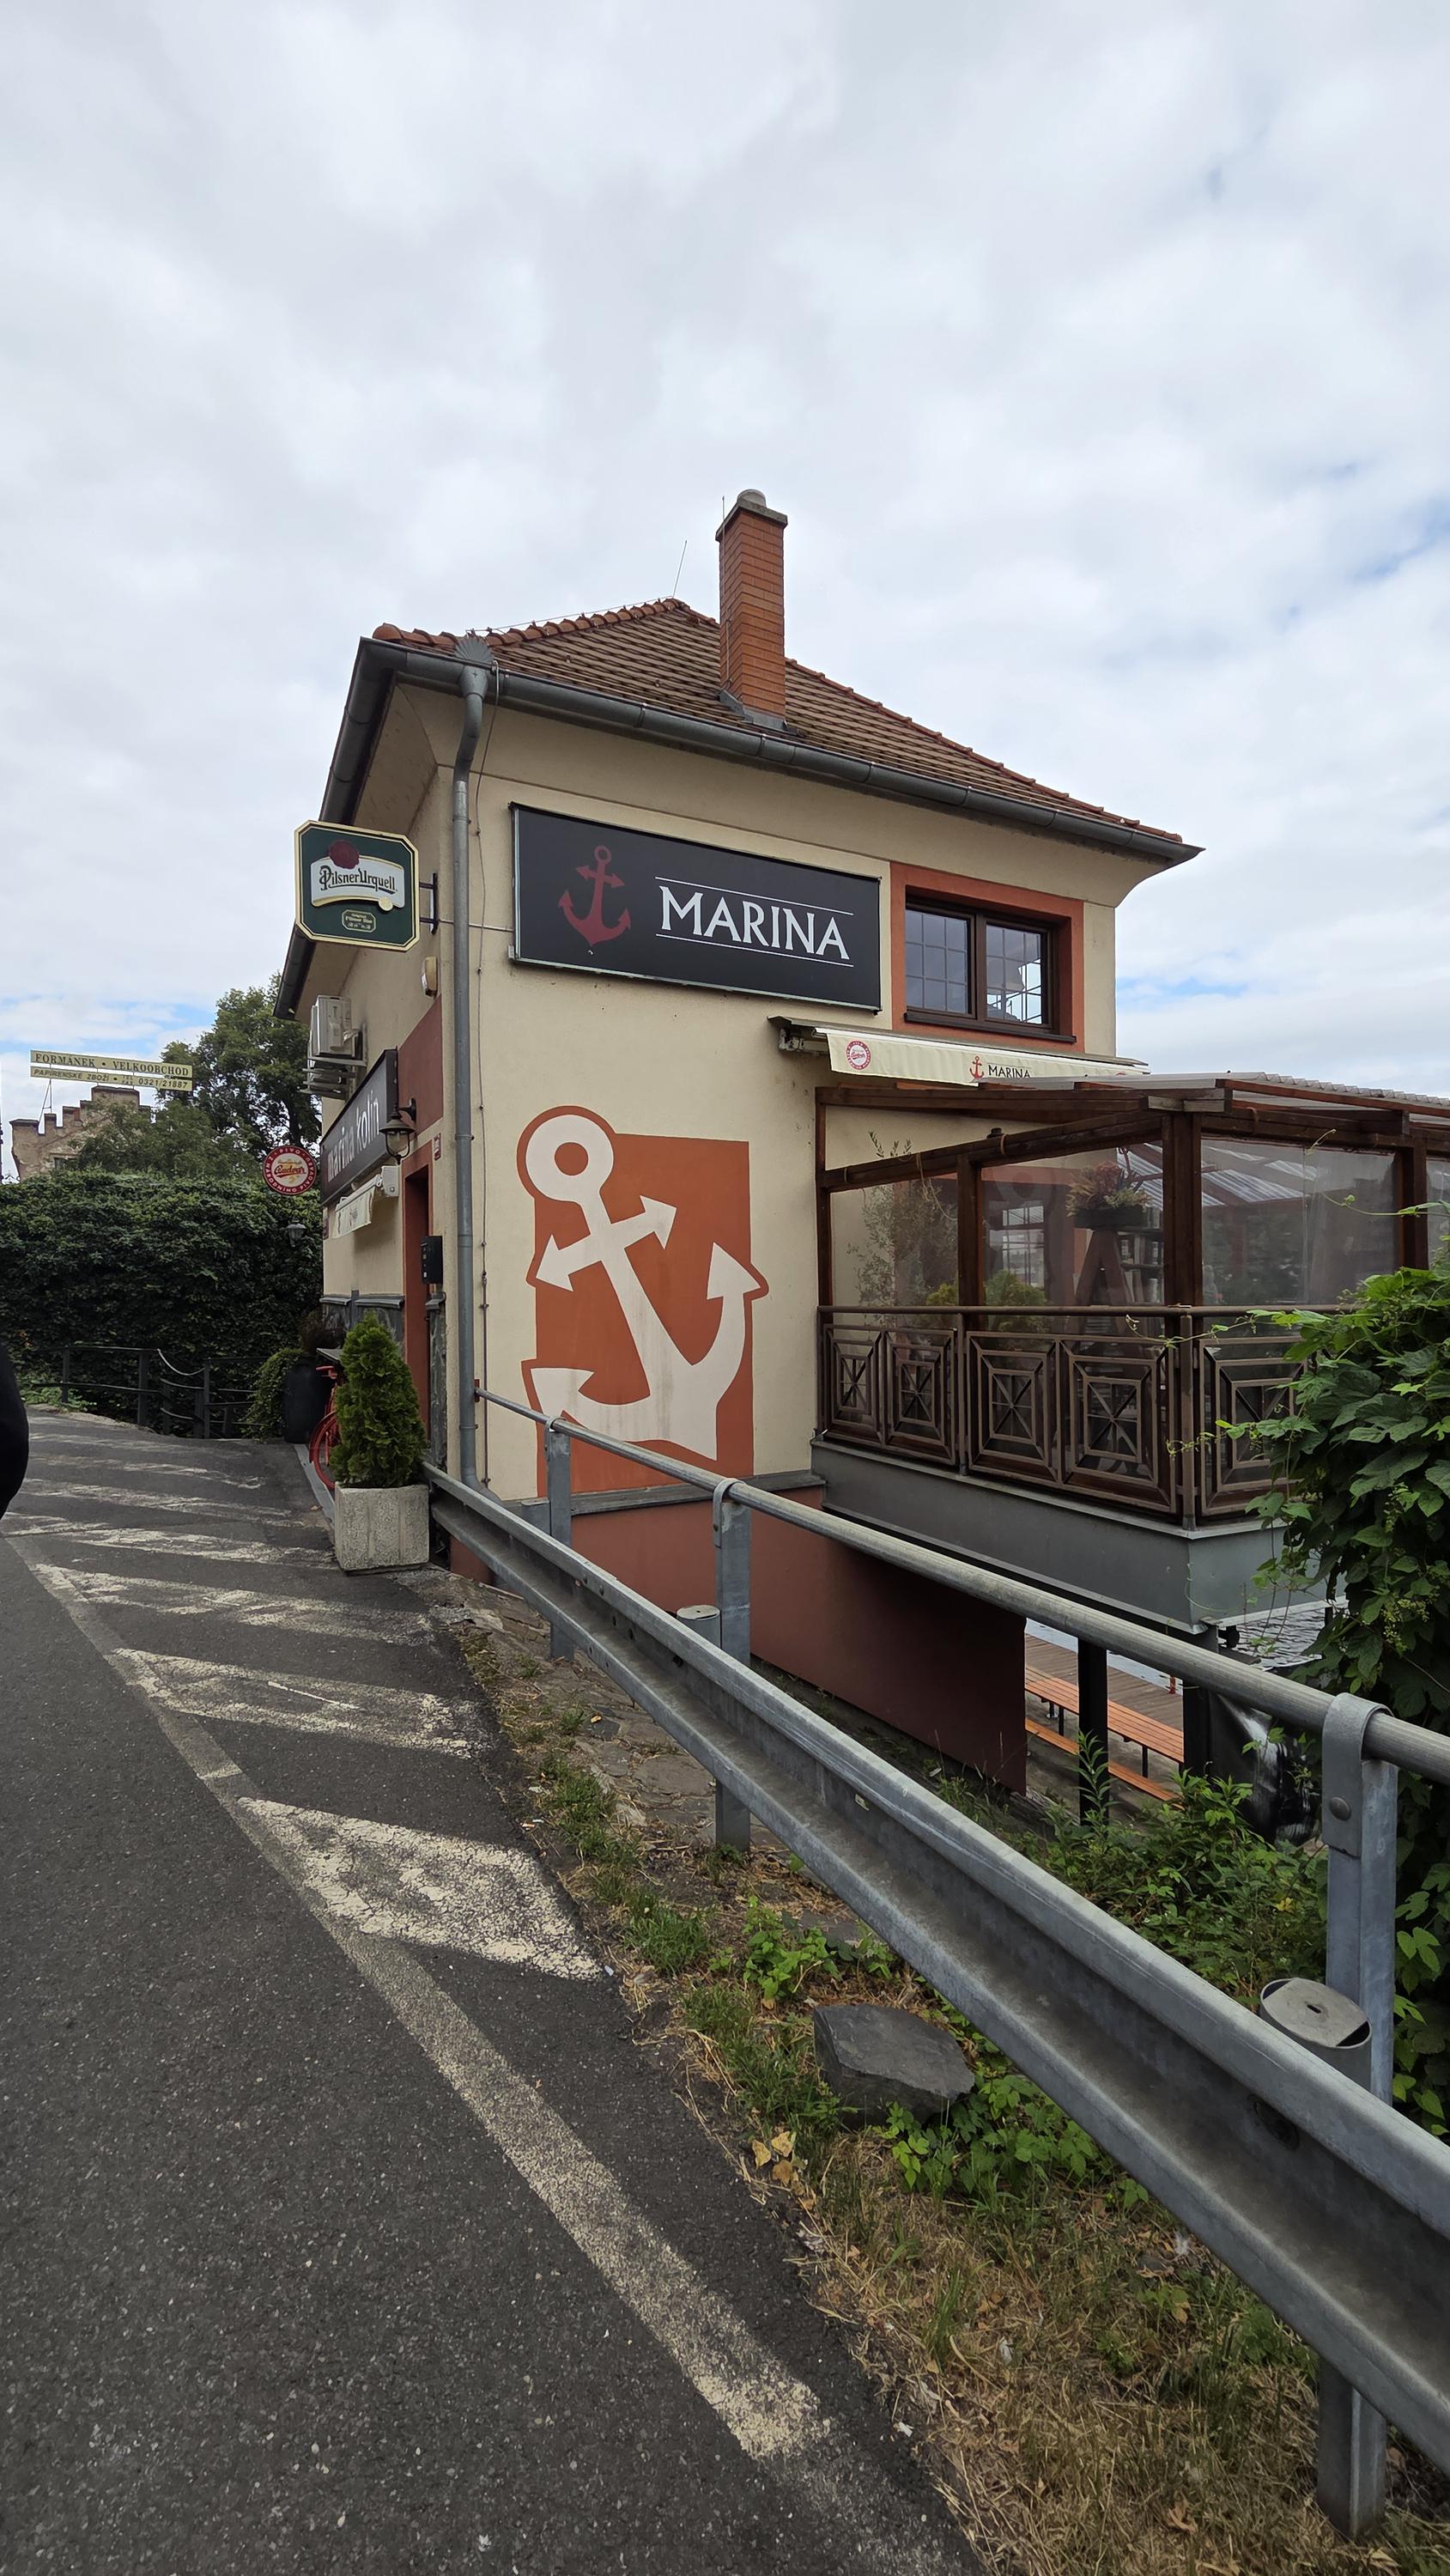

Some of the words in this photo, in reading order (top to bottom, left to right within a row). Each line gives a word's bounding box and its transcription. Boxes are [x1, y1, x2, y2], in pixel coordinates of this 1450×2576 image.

[319, 865, 359, 890] Pilsner
[358, 867, 395, 891] Urquell
[659, 885, 850, 961] MARINA
[112, 1060, 189, 1076] VELKOOBCHOD
[988, 1065, 1030, 1078] MARINA
[138, 1078, 188, 1089] 0321/21887
[328, 1125, 355, 1182] marina
